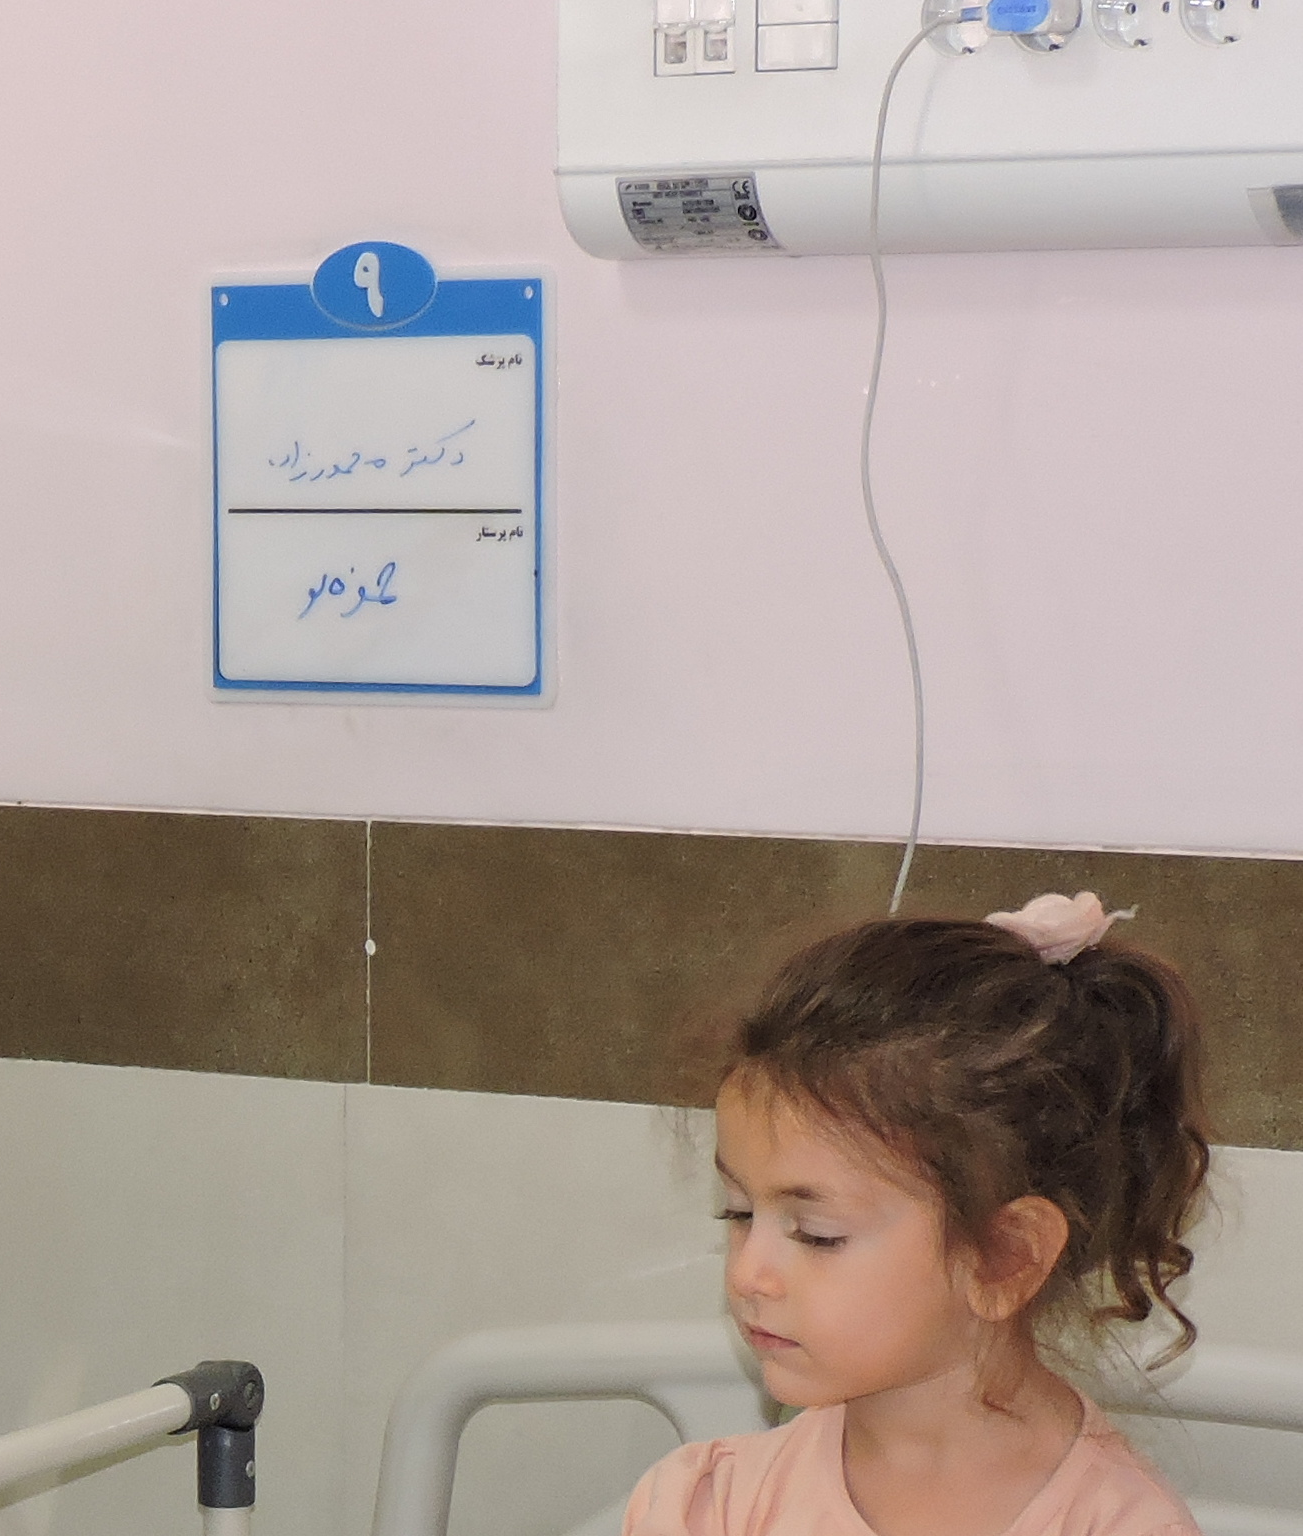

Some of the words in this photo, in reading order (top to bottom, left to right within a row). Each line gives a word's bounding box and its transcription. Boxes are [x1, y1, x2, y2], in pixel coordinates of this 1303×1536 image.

[353, 251, 385, 318] ۹
[400, 419, 475, 477] دکتر
[475, 526, 507, 542] پرستار
